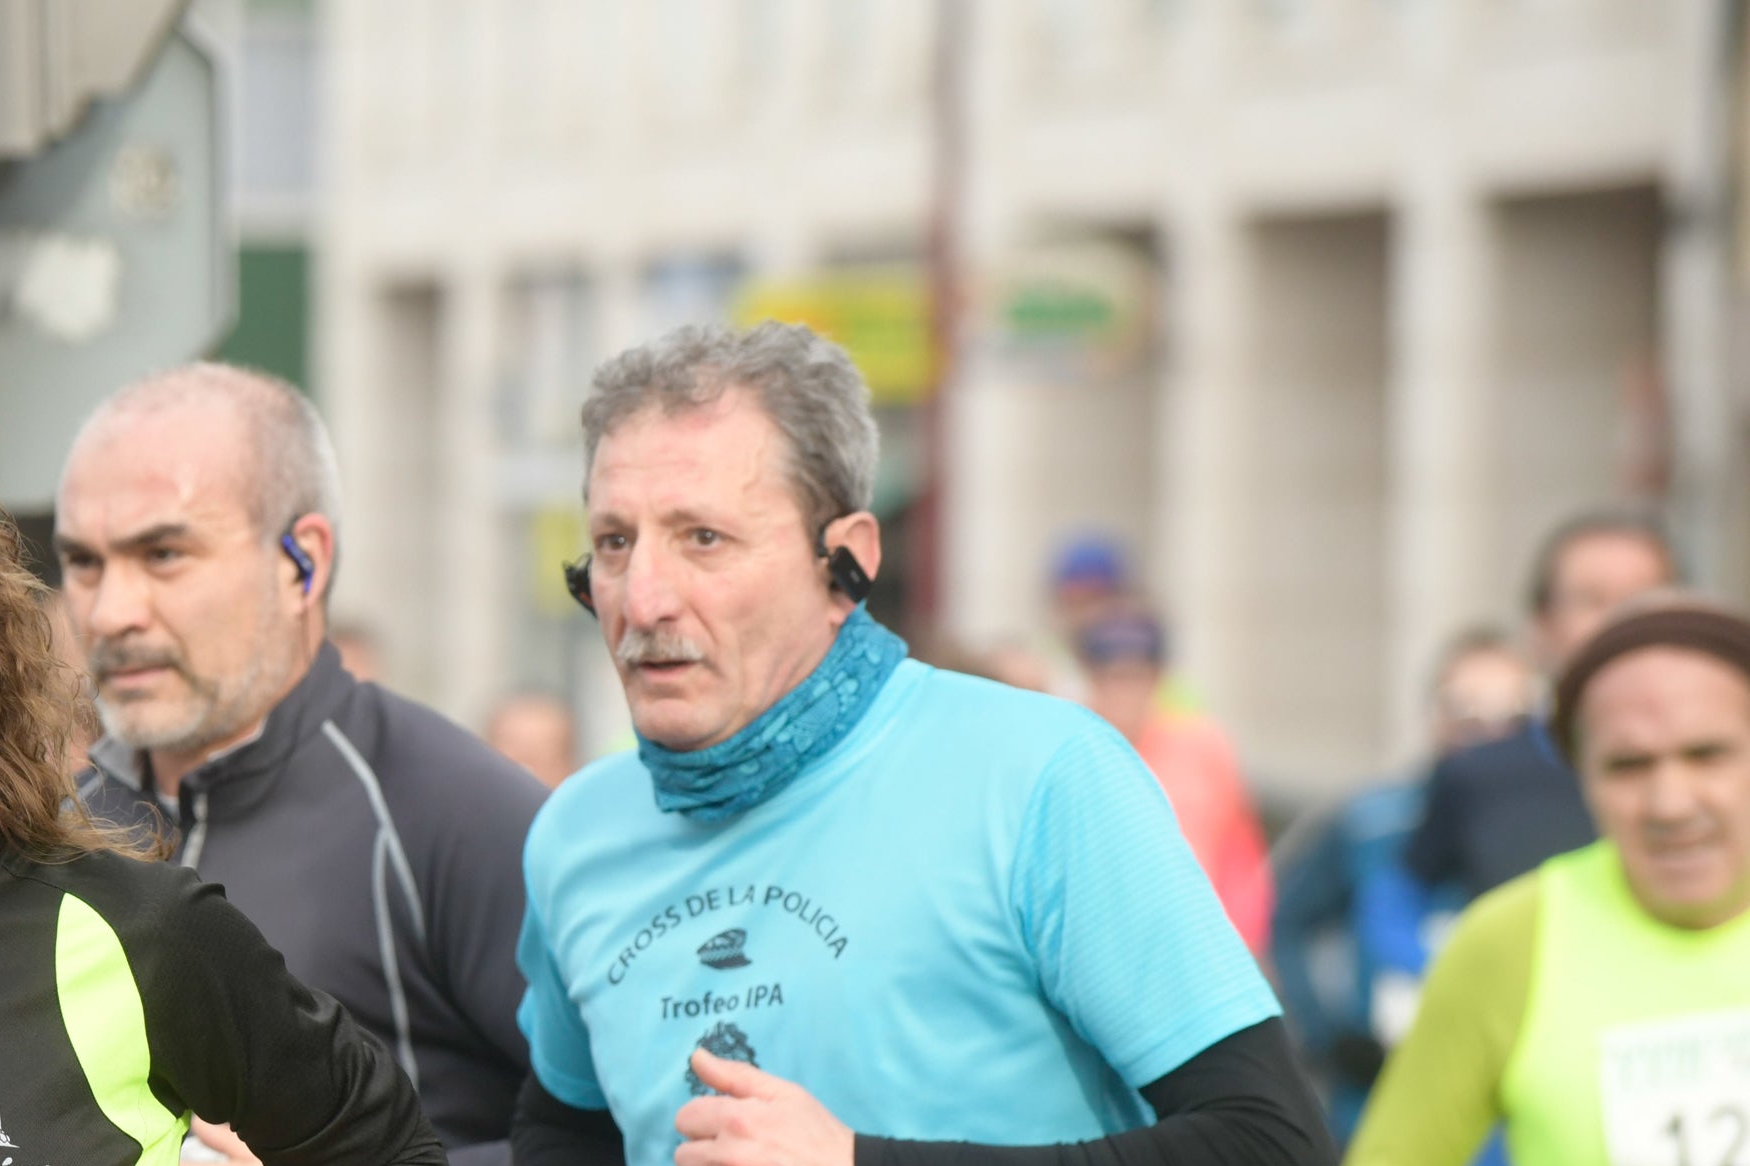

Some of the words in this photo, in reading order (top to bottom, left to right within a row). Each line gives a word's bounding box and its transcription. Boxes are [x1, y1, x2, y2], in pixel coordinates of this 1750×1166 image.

[607, 905, 682, 985] CROSS
[685, 888, 722, 918] DE
[728, 884, 755, 907] LA
[763, 885, 848, 959] POLICIA
[660, 991, 739, 1020] Trofeo
[745, 983, 784, 1008] IPA
